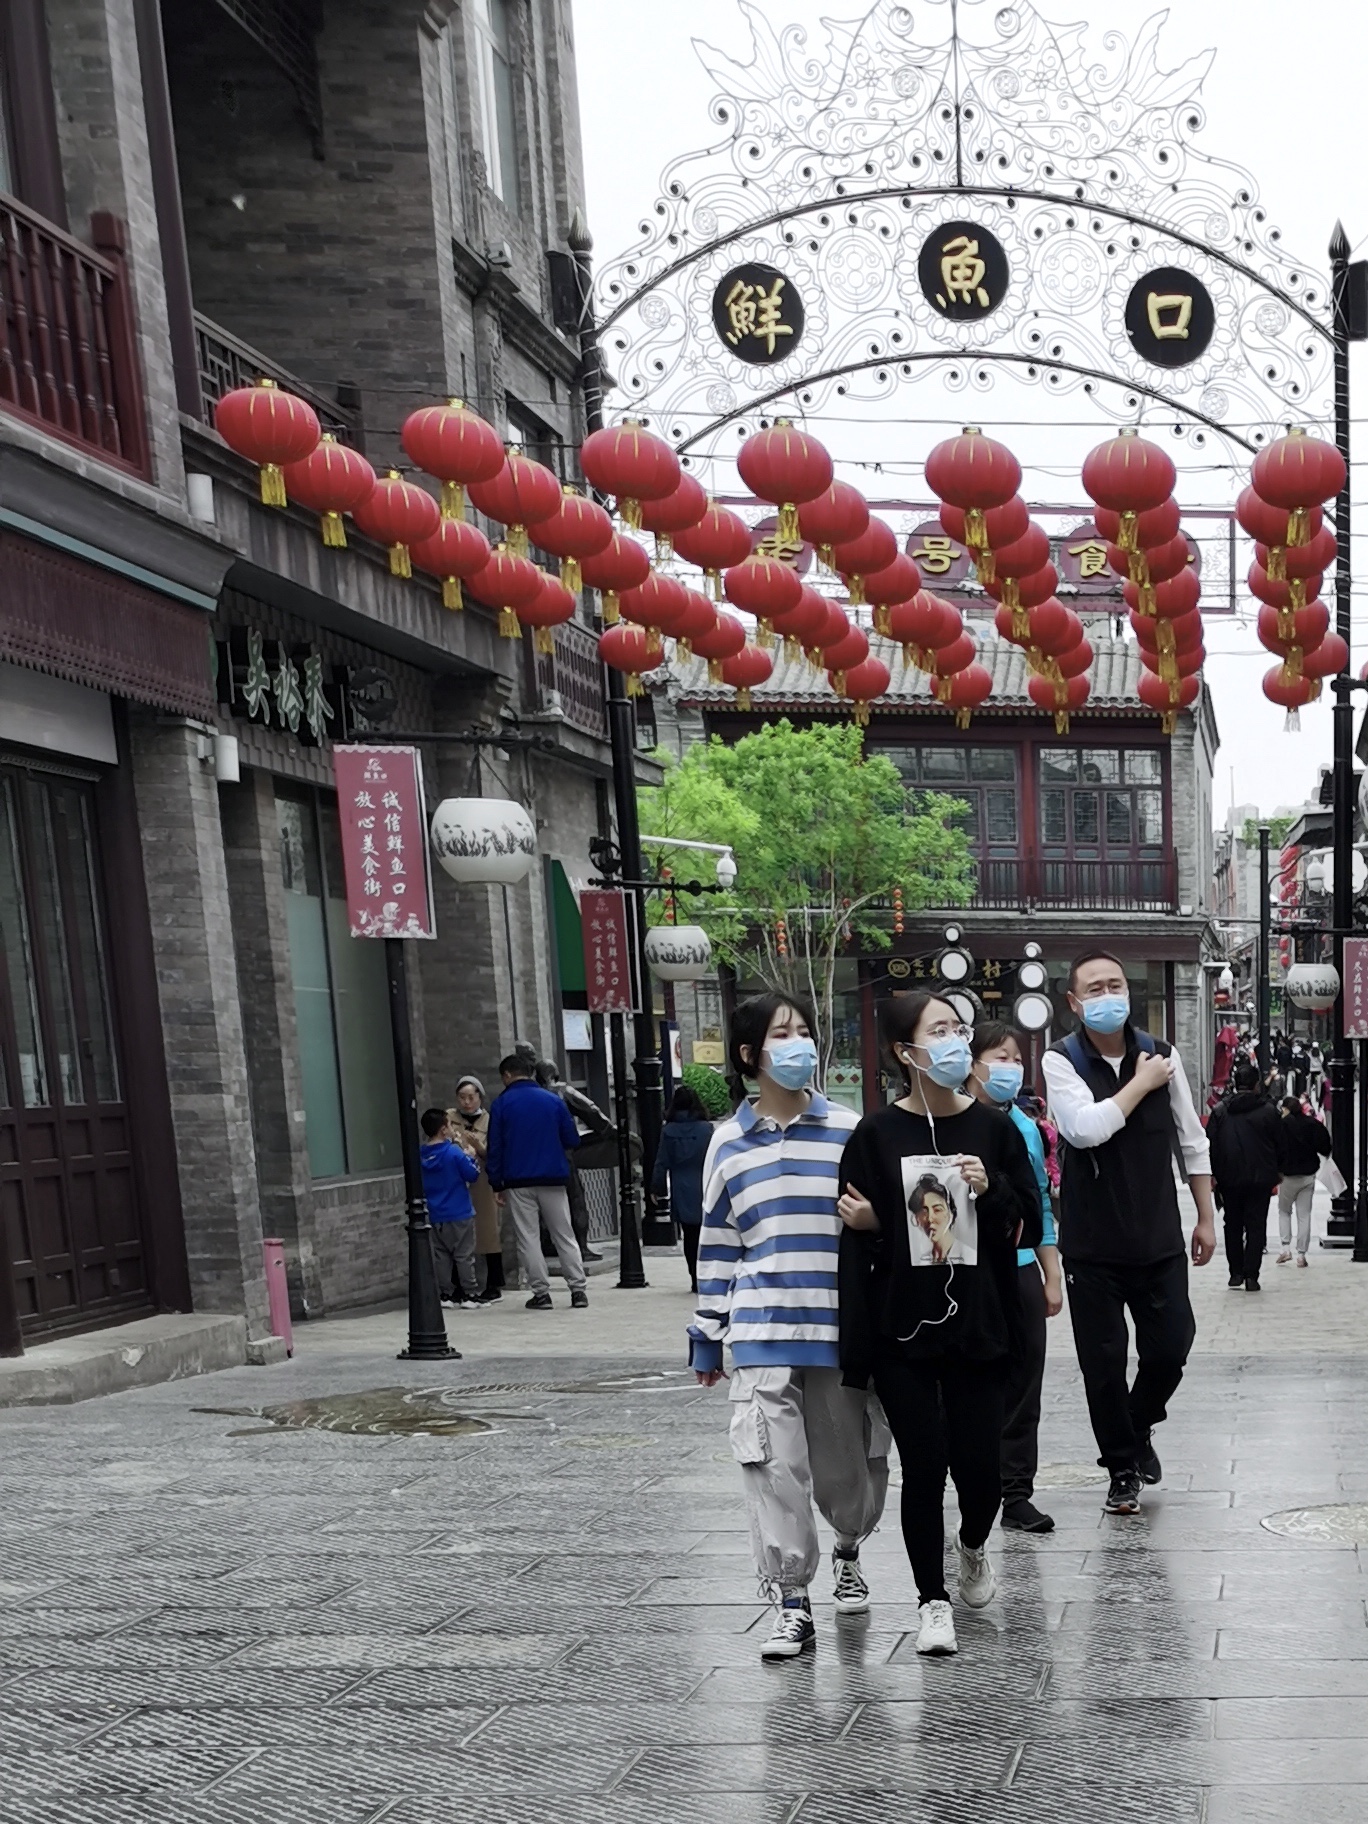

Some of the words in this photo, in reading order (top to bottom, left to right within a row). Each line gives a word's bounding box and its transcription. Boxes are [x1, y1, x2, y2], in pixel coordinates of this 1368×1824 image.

[354, 791, 382, 897] 放心美食街
[381, 790, 407, 895] 诚信鲜鱼口
